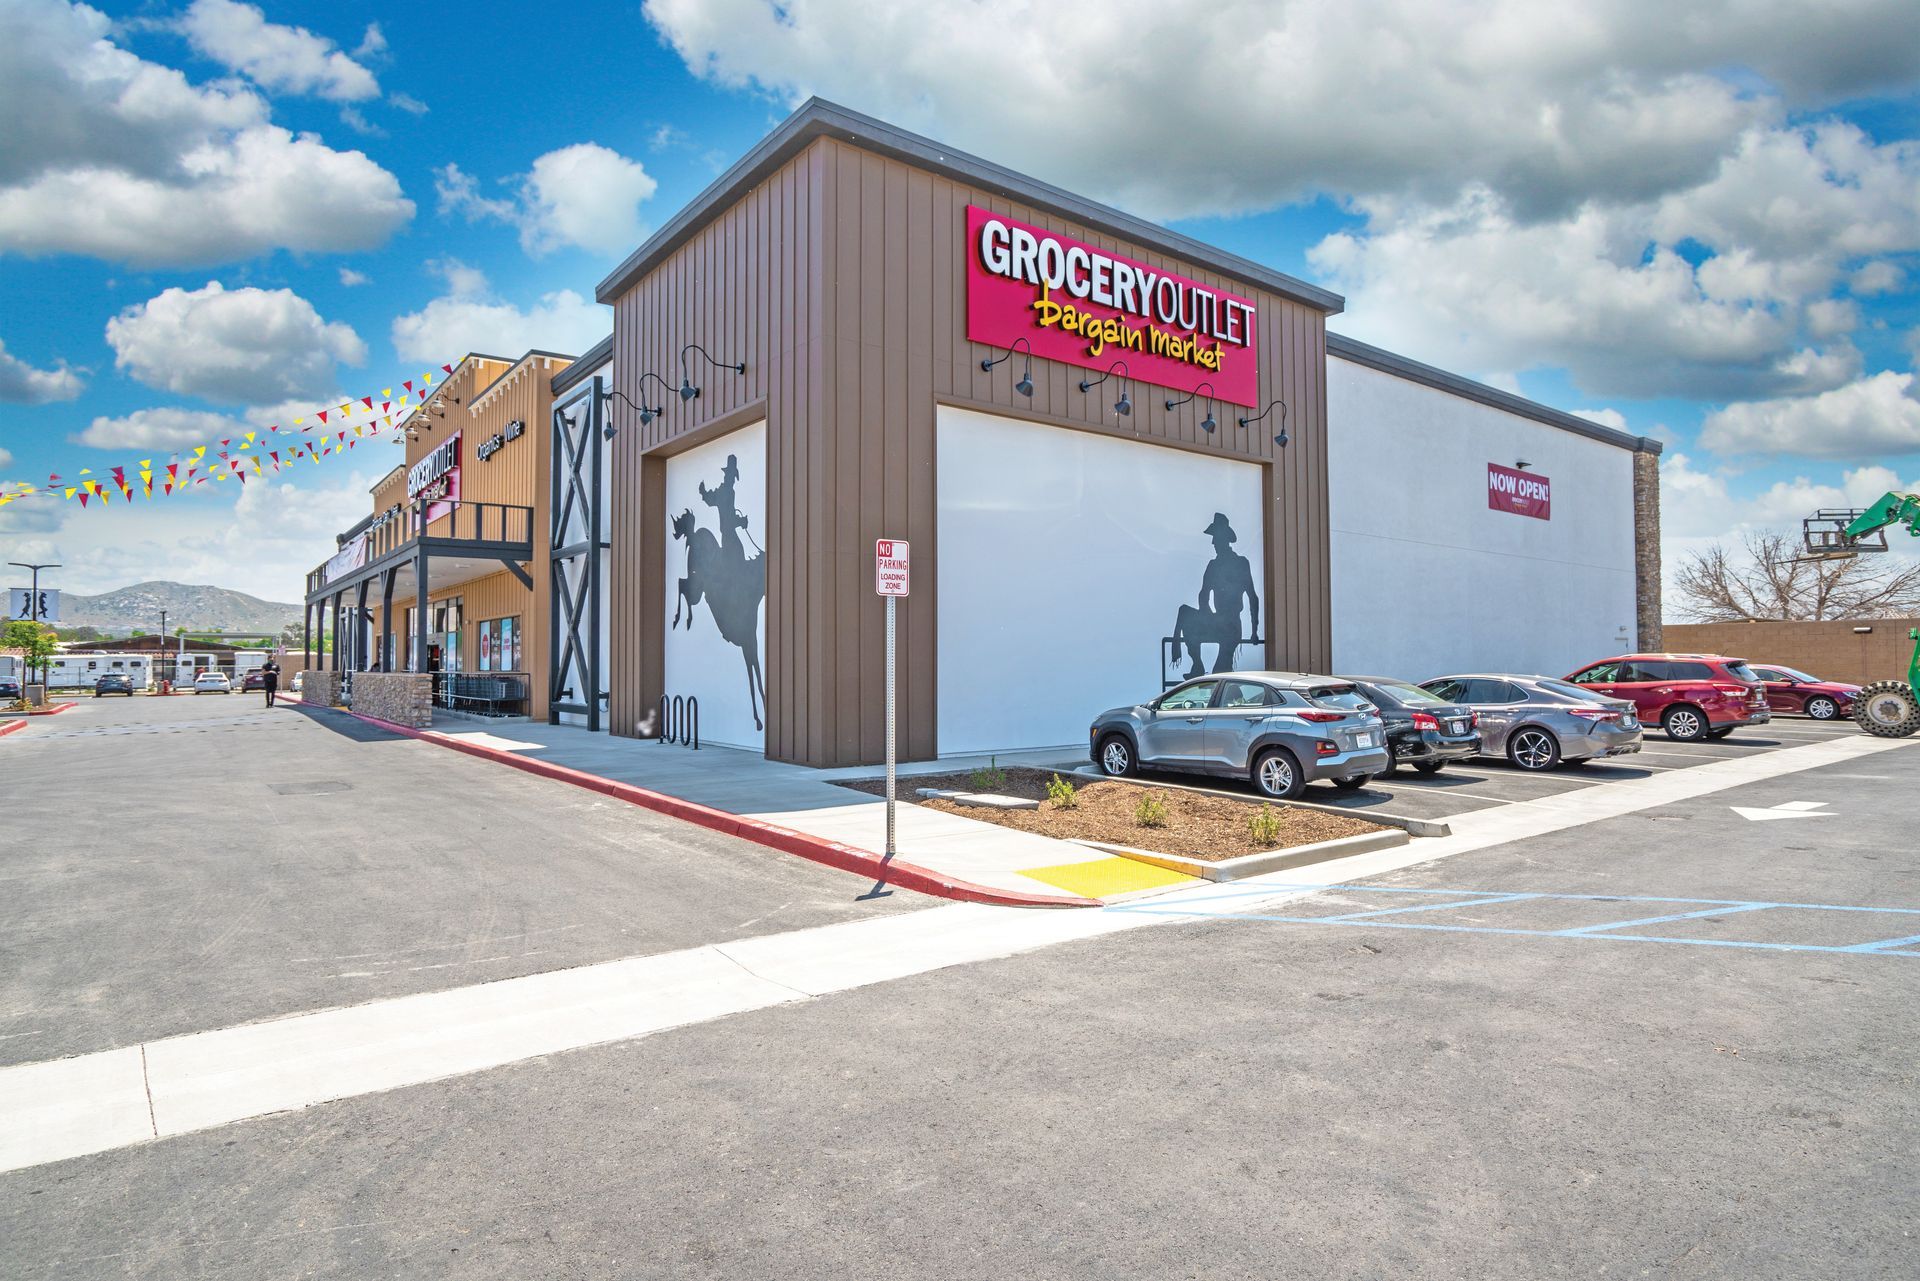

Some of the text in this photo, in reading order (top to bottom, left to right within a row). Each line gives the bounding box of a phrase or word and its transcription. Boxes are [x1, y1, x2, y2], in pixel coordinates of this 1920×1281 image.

[1489, 471, 1516, 494] NOW
[1518, 479, 1549, 502] OPEN!
[879, 543, 891, 556] NO
[879, 558, 907, 570] PARKING
[880, 573, 906, 581] LOADING
[885, 582, 901, 590] ZONE
